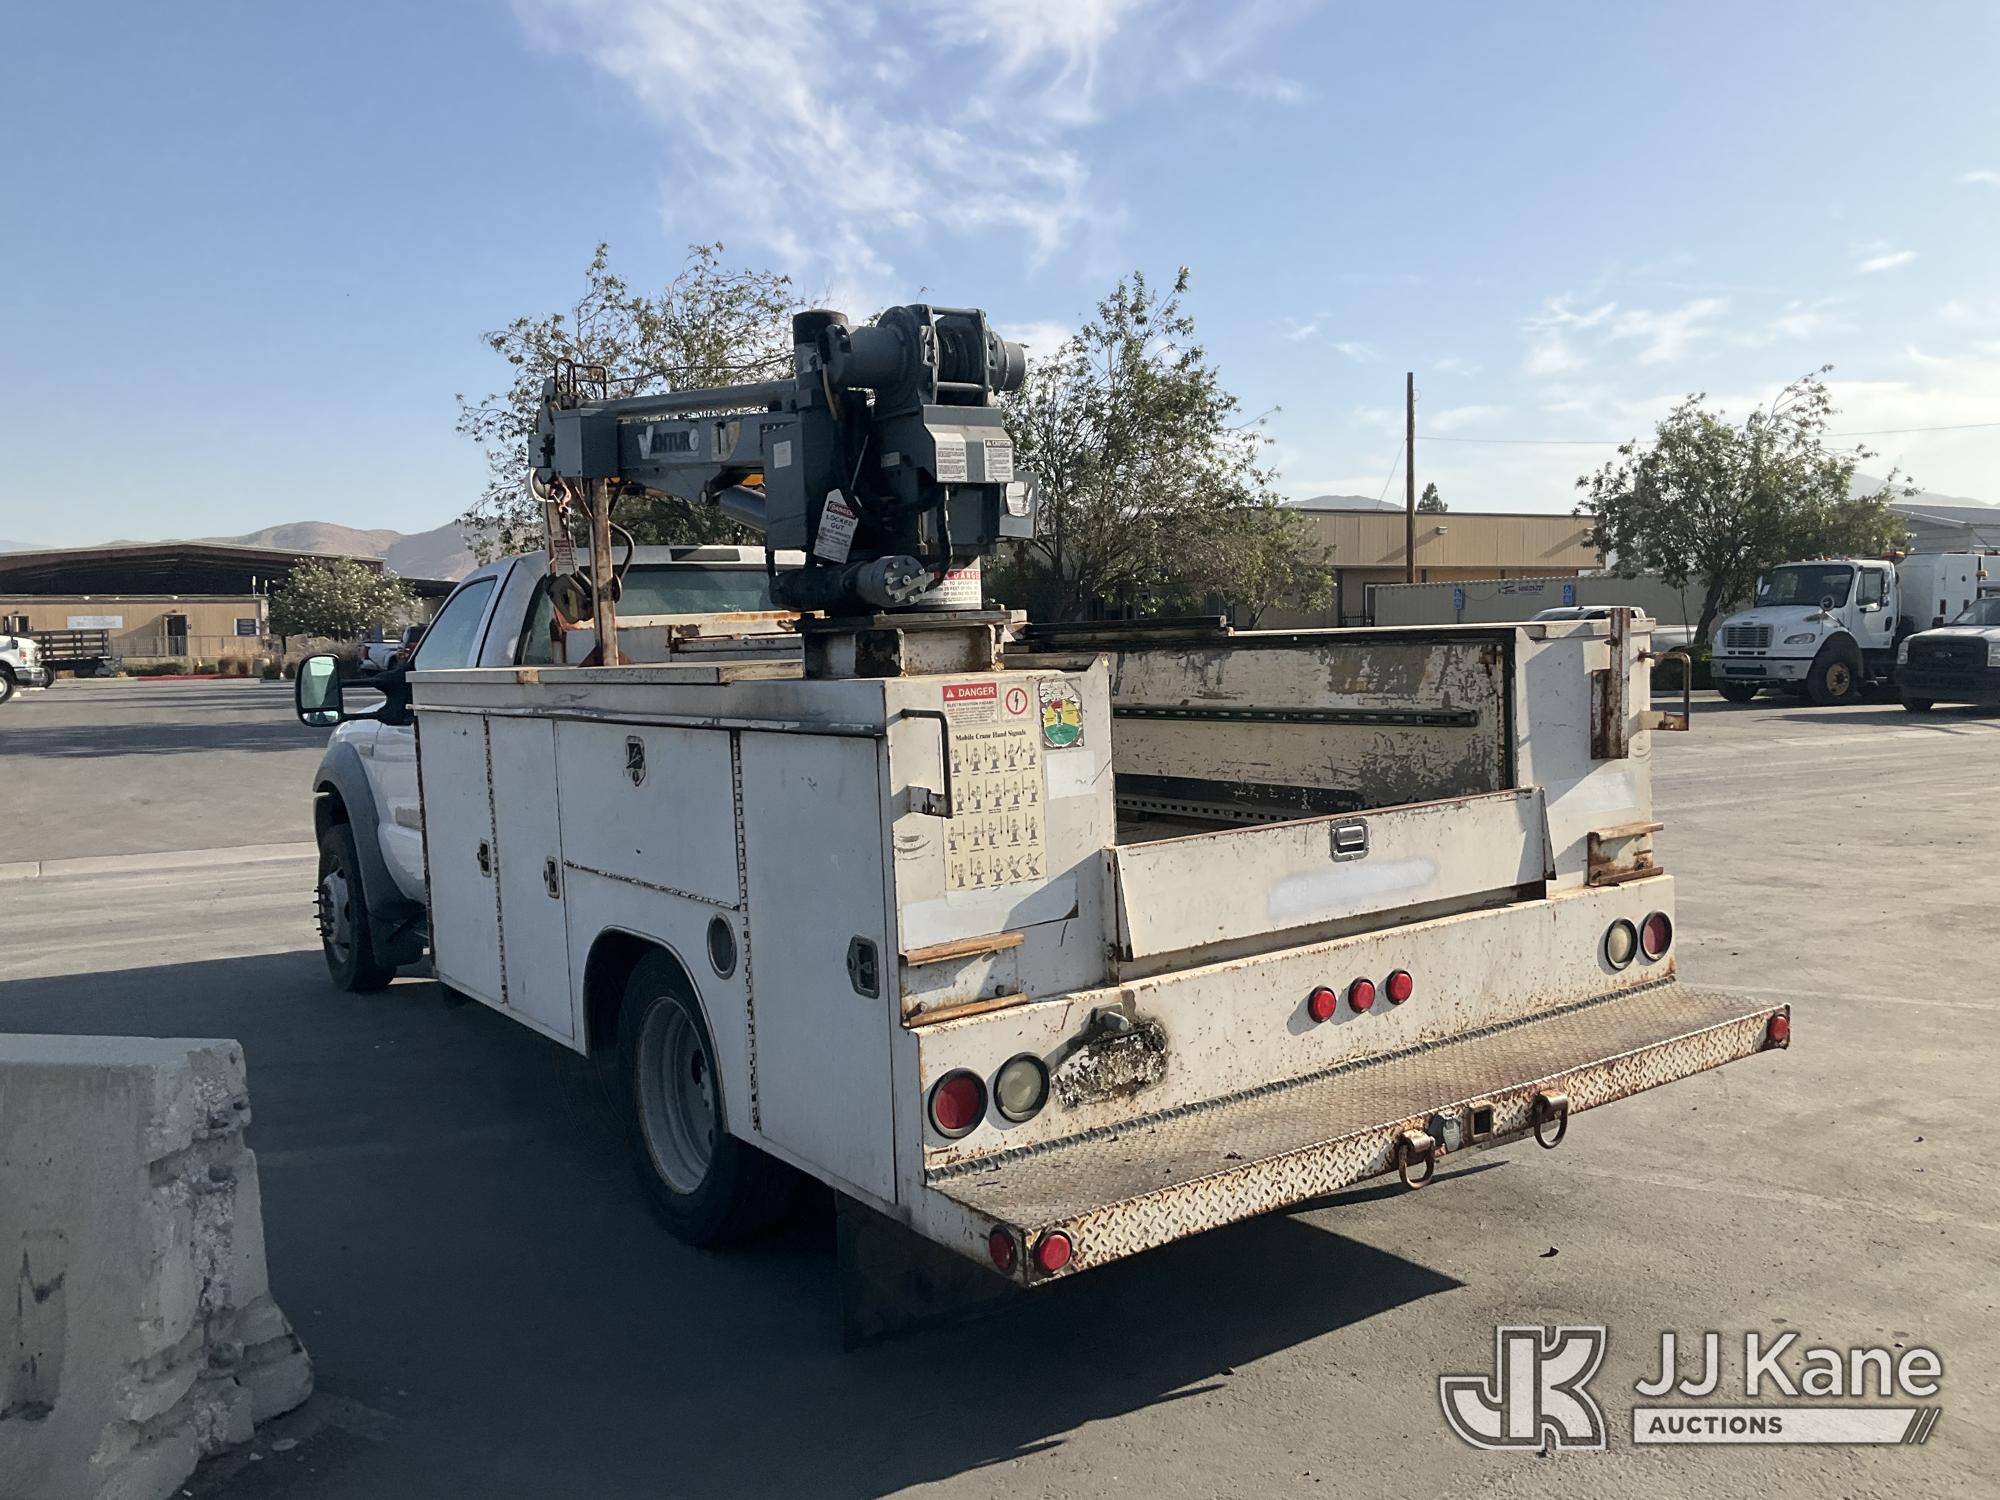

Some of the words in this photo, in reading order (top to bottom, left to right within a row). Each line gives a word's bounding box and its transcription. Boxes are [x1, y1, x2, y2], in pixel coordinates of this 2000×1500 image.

[826, 514, 854, 527] LOCKED
[958, 687, 995, 697] DANGER
[975, 732, 991, 740] Crane
[992, 730, 1006, 738] Hand
[1008, 729, 1026, 737] Signals
